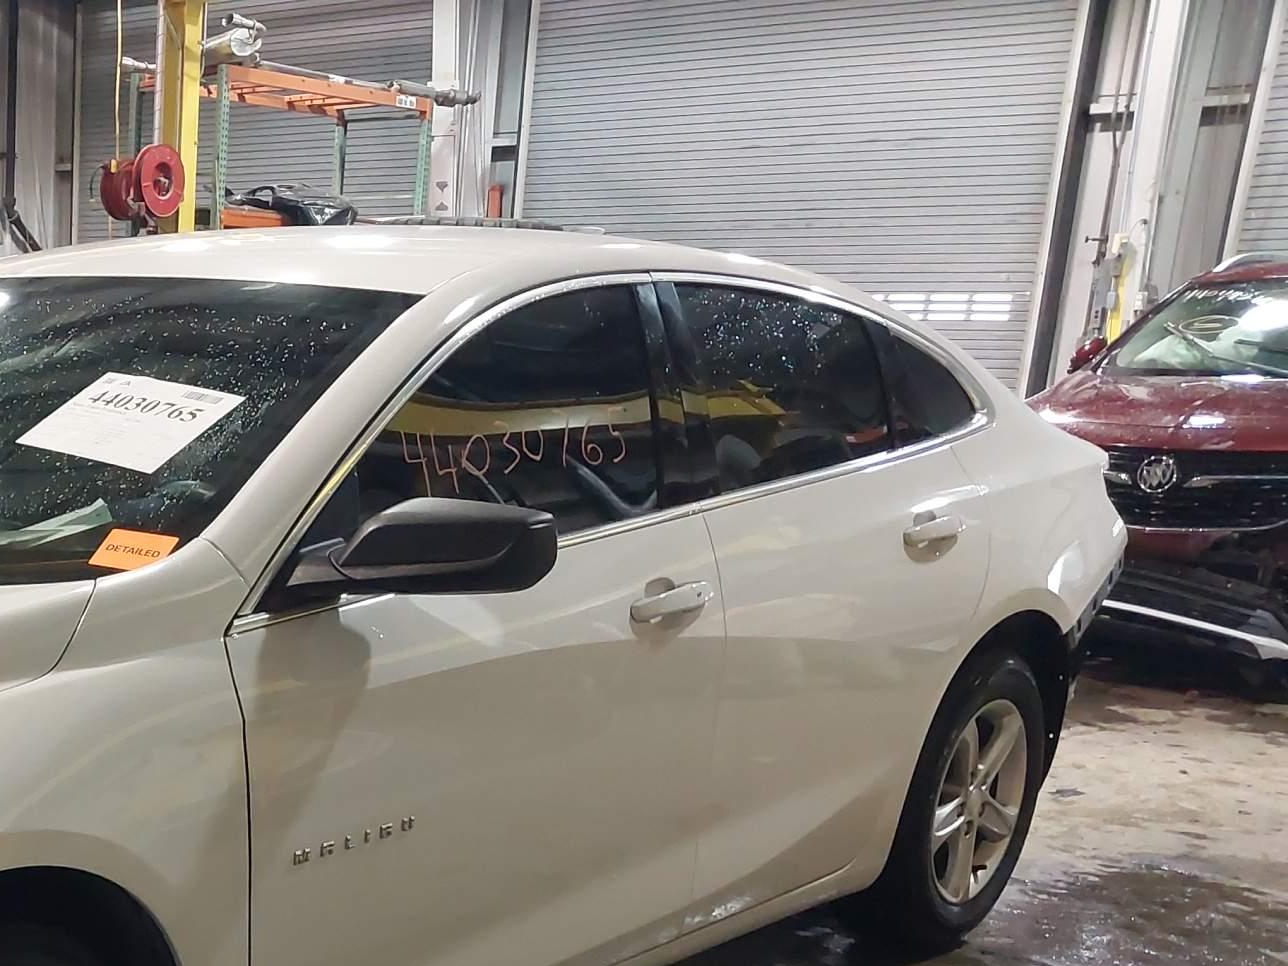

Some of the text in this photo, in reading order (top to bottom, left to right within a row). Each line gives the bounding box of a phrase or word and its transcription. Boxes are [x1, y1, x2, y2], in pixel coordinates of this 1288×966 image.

[88, 390, 206, 423] 44030765
[399, 406, 628, 497] 44030765
[105, 543, 162, 558] DETAILED
